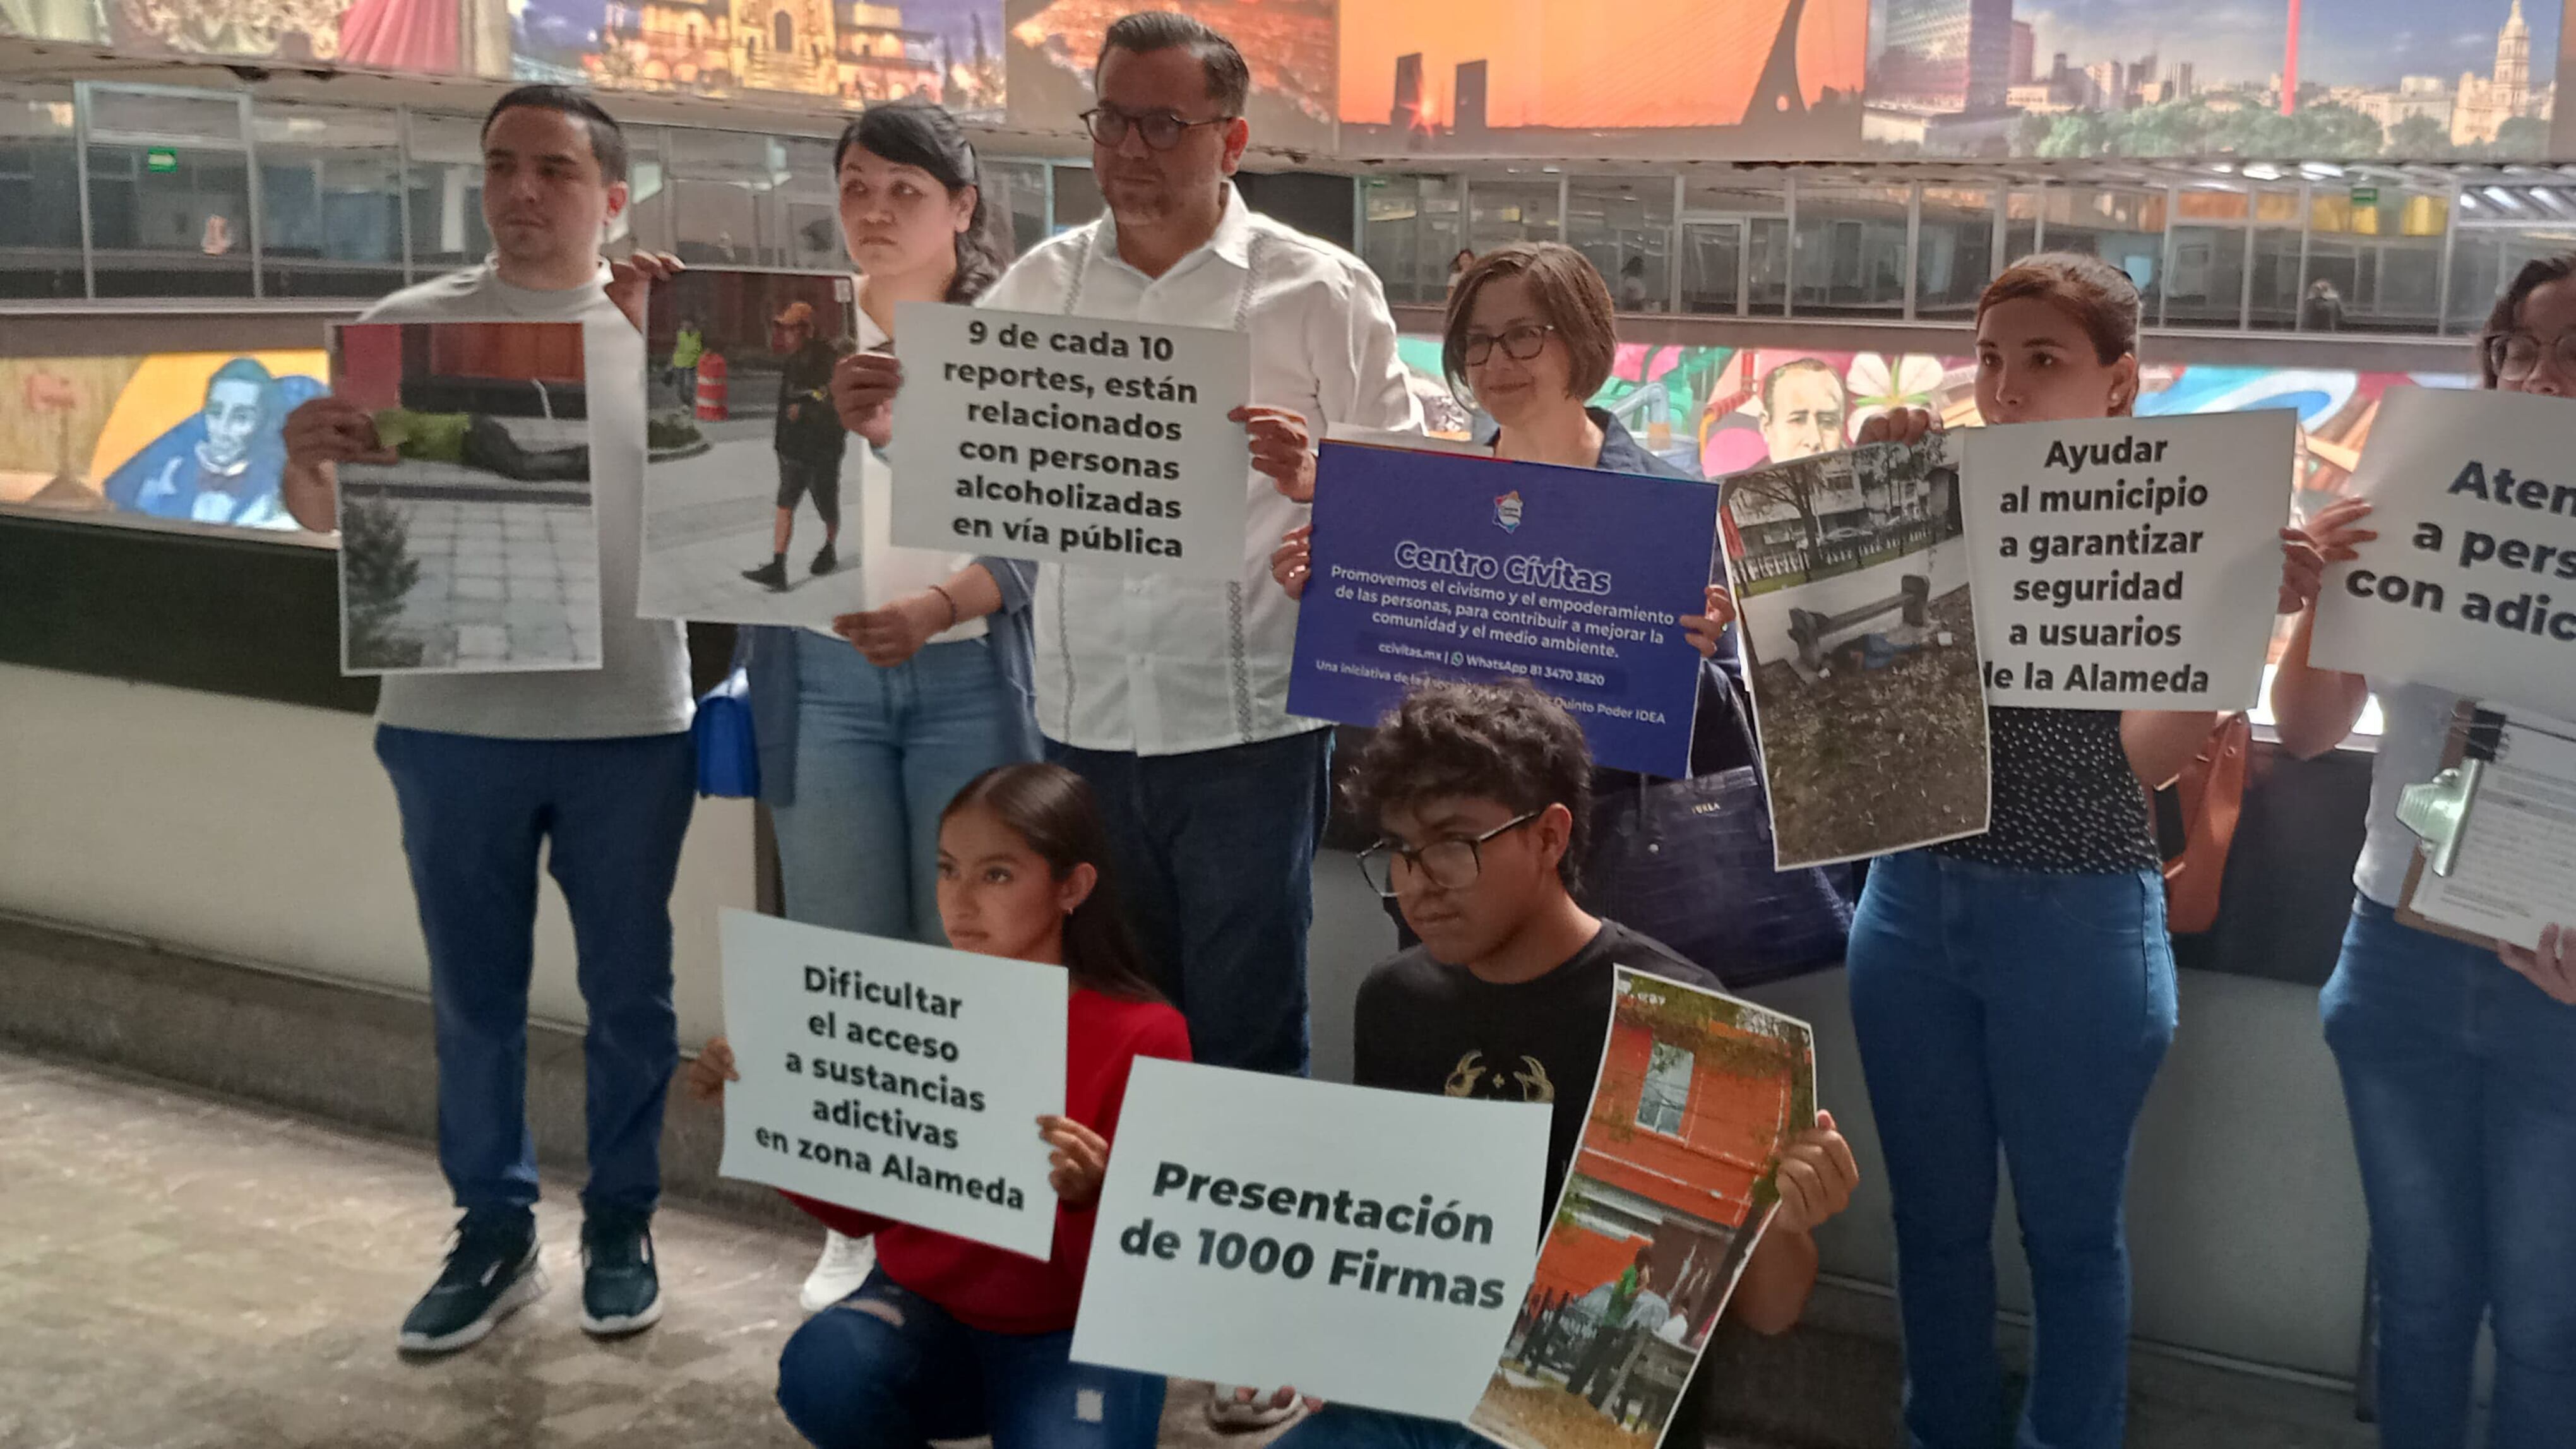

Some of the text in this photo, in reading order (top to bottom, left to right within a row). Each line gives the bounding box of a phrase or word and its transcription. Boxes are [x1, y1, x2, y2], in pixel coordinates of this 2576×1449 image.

[969, 320, 1173, 361] 9 de cada 10
[945, 362, 1197, 403] reportes, están
[968, 400, 1182, 441] relacionados
[959, 441, 1179, 480] con personas
[2044, 435, 2168, 474] Ayudar
[955, 474, 1182, 519] alcoholizadas
[2000, 475, 2208, 516] al municipio
[2448, 460, 2576, 518] Aten
[952, 517, 1183, 558] en vía pública
[1999, 523, 2204, 564] a garantizar
[2412, 522, 2443, 552] a
[1394, 540, 1611, 595] Centro Cívitas
[2013, 569, 2183, 609] seguridad
[1331, 564, 1674, 626] Promovemos el civismo y el empoderamiento
[2345, 569, 2444, 612] con
[1335, 585, 1664, 644] de las personas, para contribuir a mejorar la
[1372, 612, 1619, 658] comunidad y el medio ambiente.
[2009, 614, 2181, 647] a usuarios
[1316, 660, 1339, 672] Una
[1340, 663, 1392, 681] iniciativa
[1597, 703, 1633, 719] Poder
[1635, 709, 1666, 724] IDEA
[1466, 654, 1528, 675] WhatsApp
[1529, 664, 1542, 676] 81
[1544, 666, 1573, 681] 3470
[1575, 671, 1605, 686] 3820
[2024, 662, 2053, 690] la
[2063, 662, 2209, 693] Alameda
[804, 965, 962, 1019] Dificultar
[808, 1011, 958, 1063] el acceso
[785, 1052, 985, 1112] a sustancias
[813, 1099, 958, 1150] adictivas
[755, 1127, 1024, 1210] en zona Alameda
[1153, 1162, 1493, 1244] Presentación
[1120, 1219, 1505, 1309] de 1000 Firmas
